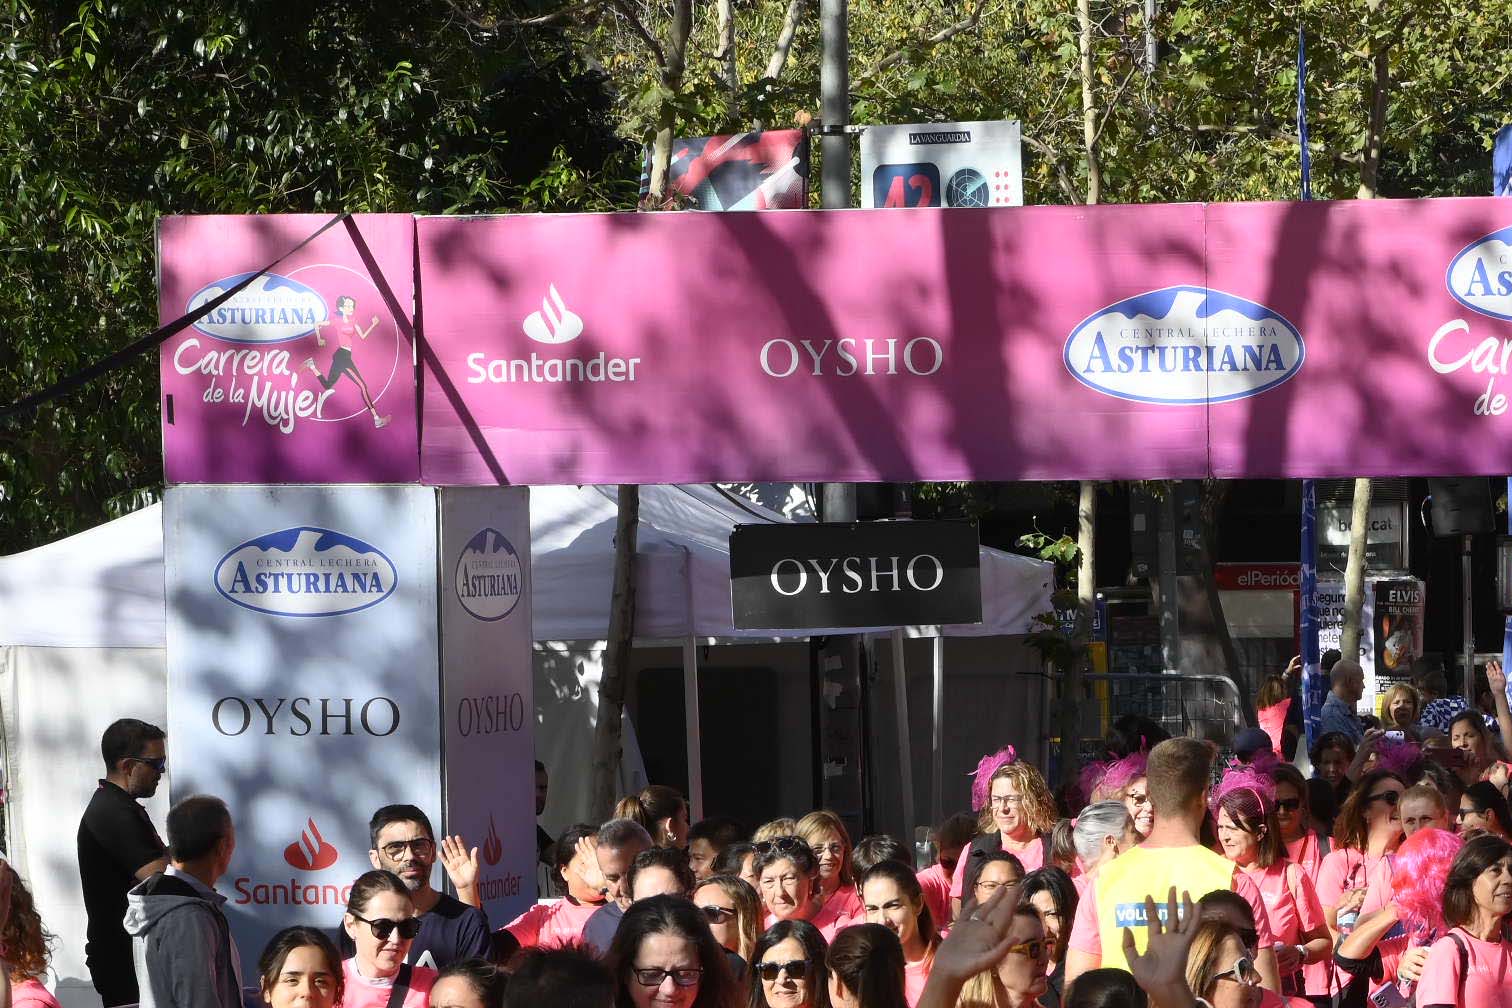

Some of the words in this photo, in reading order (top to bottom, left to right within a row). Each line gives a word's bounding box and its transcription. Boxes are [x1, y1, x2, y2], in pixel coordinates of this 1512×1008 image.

[1083, 331, 1285, 374] ASTURIANA
[1121, 327, 1196, 338] CENTRAL
[174, 337, 291, 377] Carrera
[467, 352, 641, 383] Santander
[759, 337, 943, 378] OYSHO
[203, 379, 225, 404] de
[229, 378, 245, 404] la
[242, 371, 336, 434] Mujer
[1473, 377, 1510, 416] de
[228, 561, 385, 595] ASTURIANA
[255, 558, 312, 568] CENTRAL
[320, 558, 378, 568] LECHERA
[461, 562, 518, 598] ASTURIANA
[770, 555, 944, 597] OYSHO
[211, 696, 401, 737] OYSHO
[457, 692, 524, 737] OYSHO
